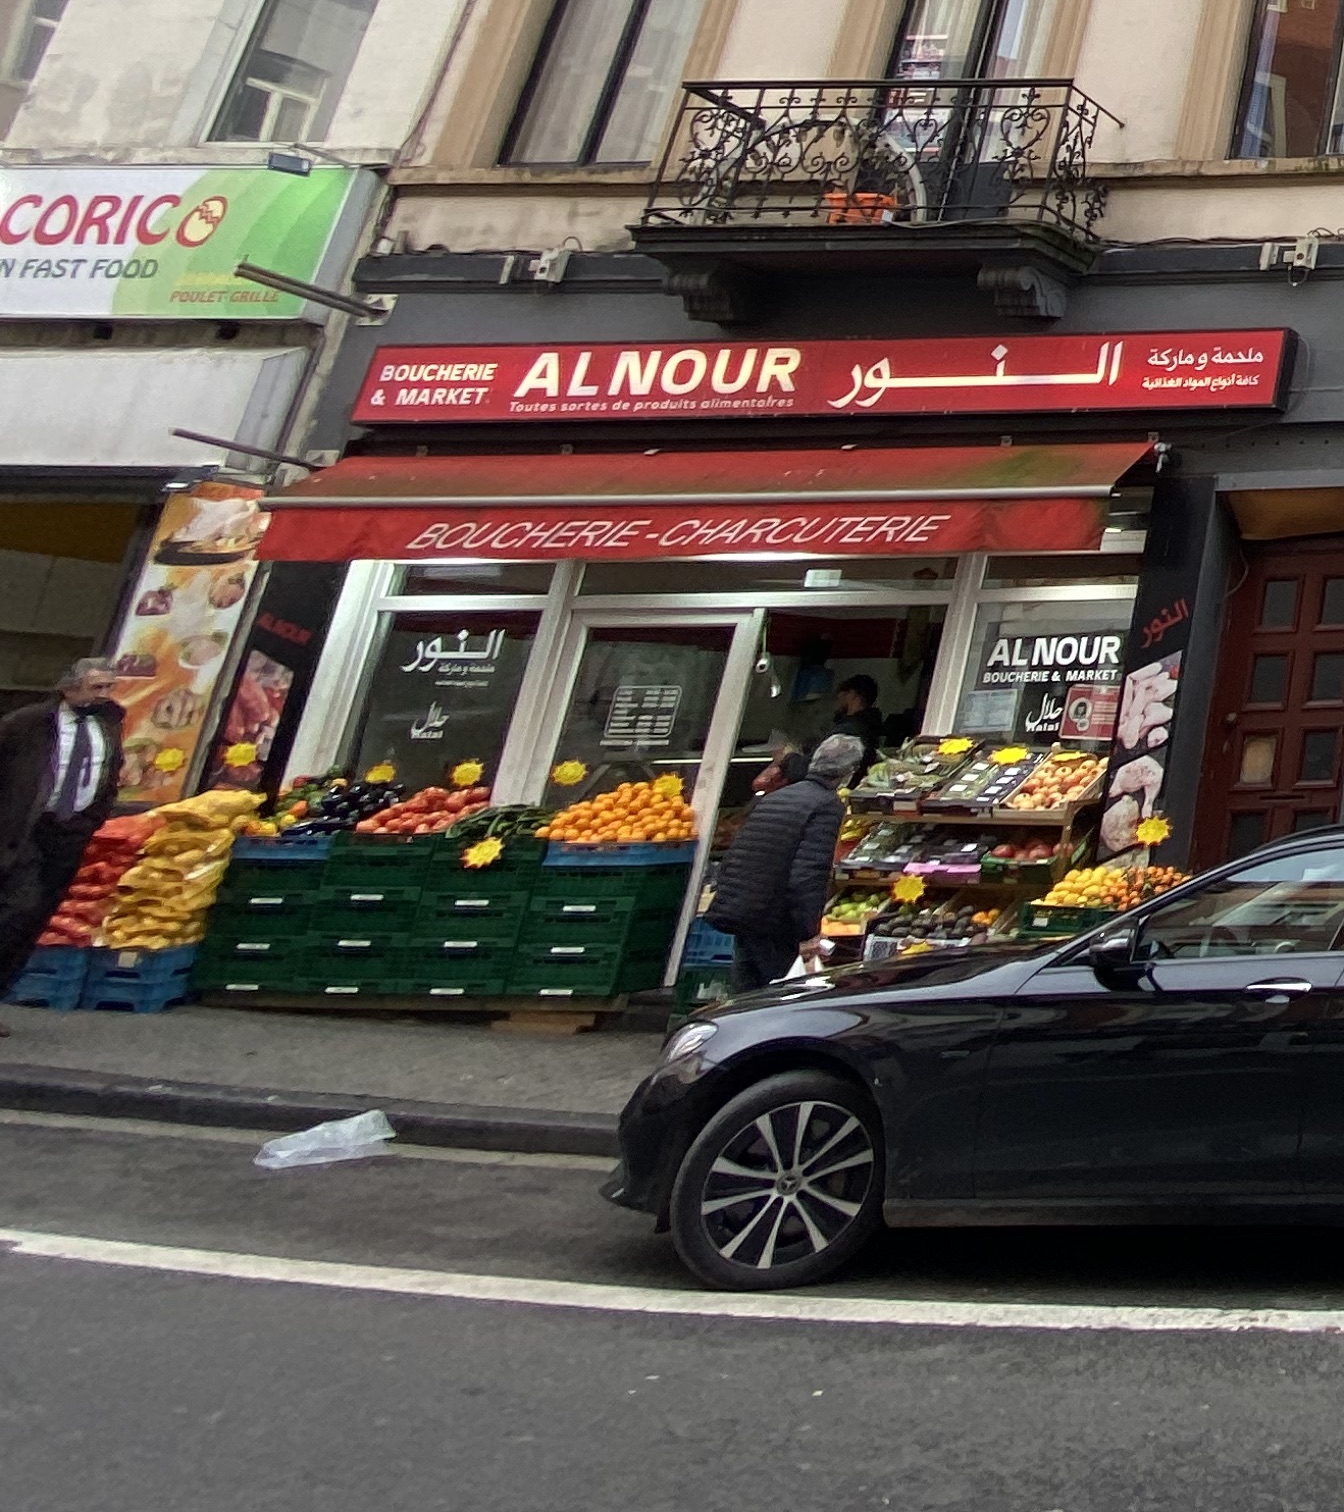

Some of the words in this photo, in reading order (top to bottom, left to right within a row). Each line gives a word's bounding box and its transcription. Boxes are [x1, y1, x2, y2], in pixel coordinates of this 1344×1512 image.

[18, 258, 89, 279] FAST
[89, 258, 159, 279] FOOD
[169, 290, 228, 303] POULET
[1147, 348, 1195, 371] ماركة
[1211, 346, 1264, 364] ملحمة
[379, 363, 498, 382] BOUCHERIE
[827, 341, 1124, 409] النور
[370, 392, 385, 405] &
[395, 387, 488, 405] MARKET
[509, 401, 556, 413] Toutes
[560, 400, 608, 412] sortes
[612, 399, 630, 411] de
[633, 399, 697, 412] produits
[701, 396, 794, 410] alimentaires
[400, 629, 506, 673] النور
[983, 670, 1050, 684] BOUCHERIE
[1051, 671, 1060, 683] &
[1065, 669, 1118, 682] MARKET
